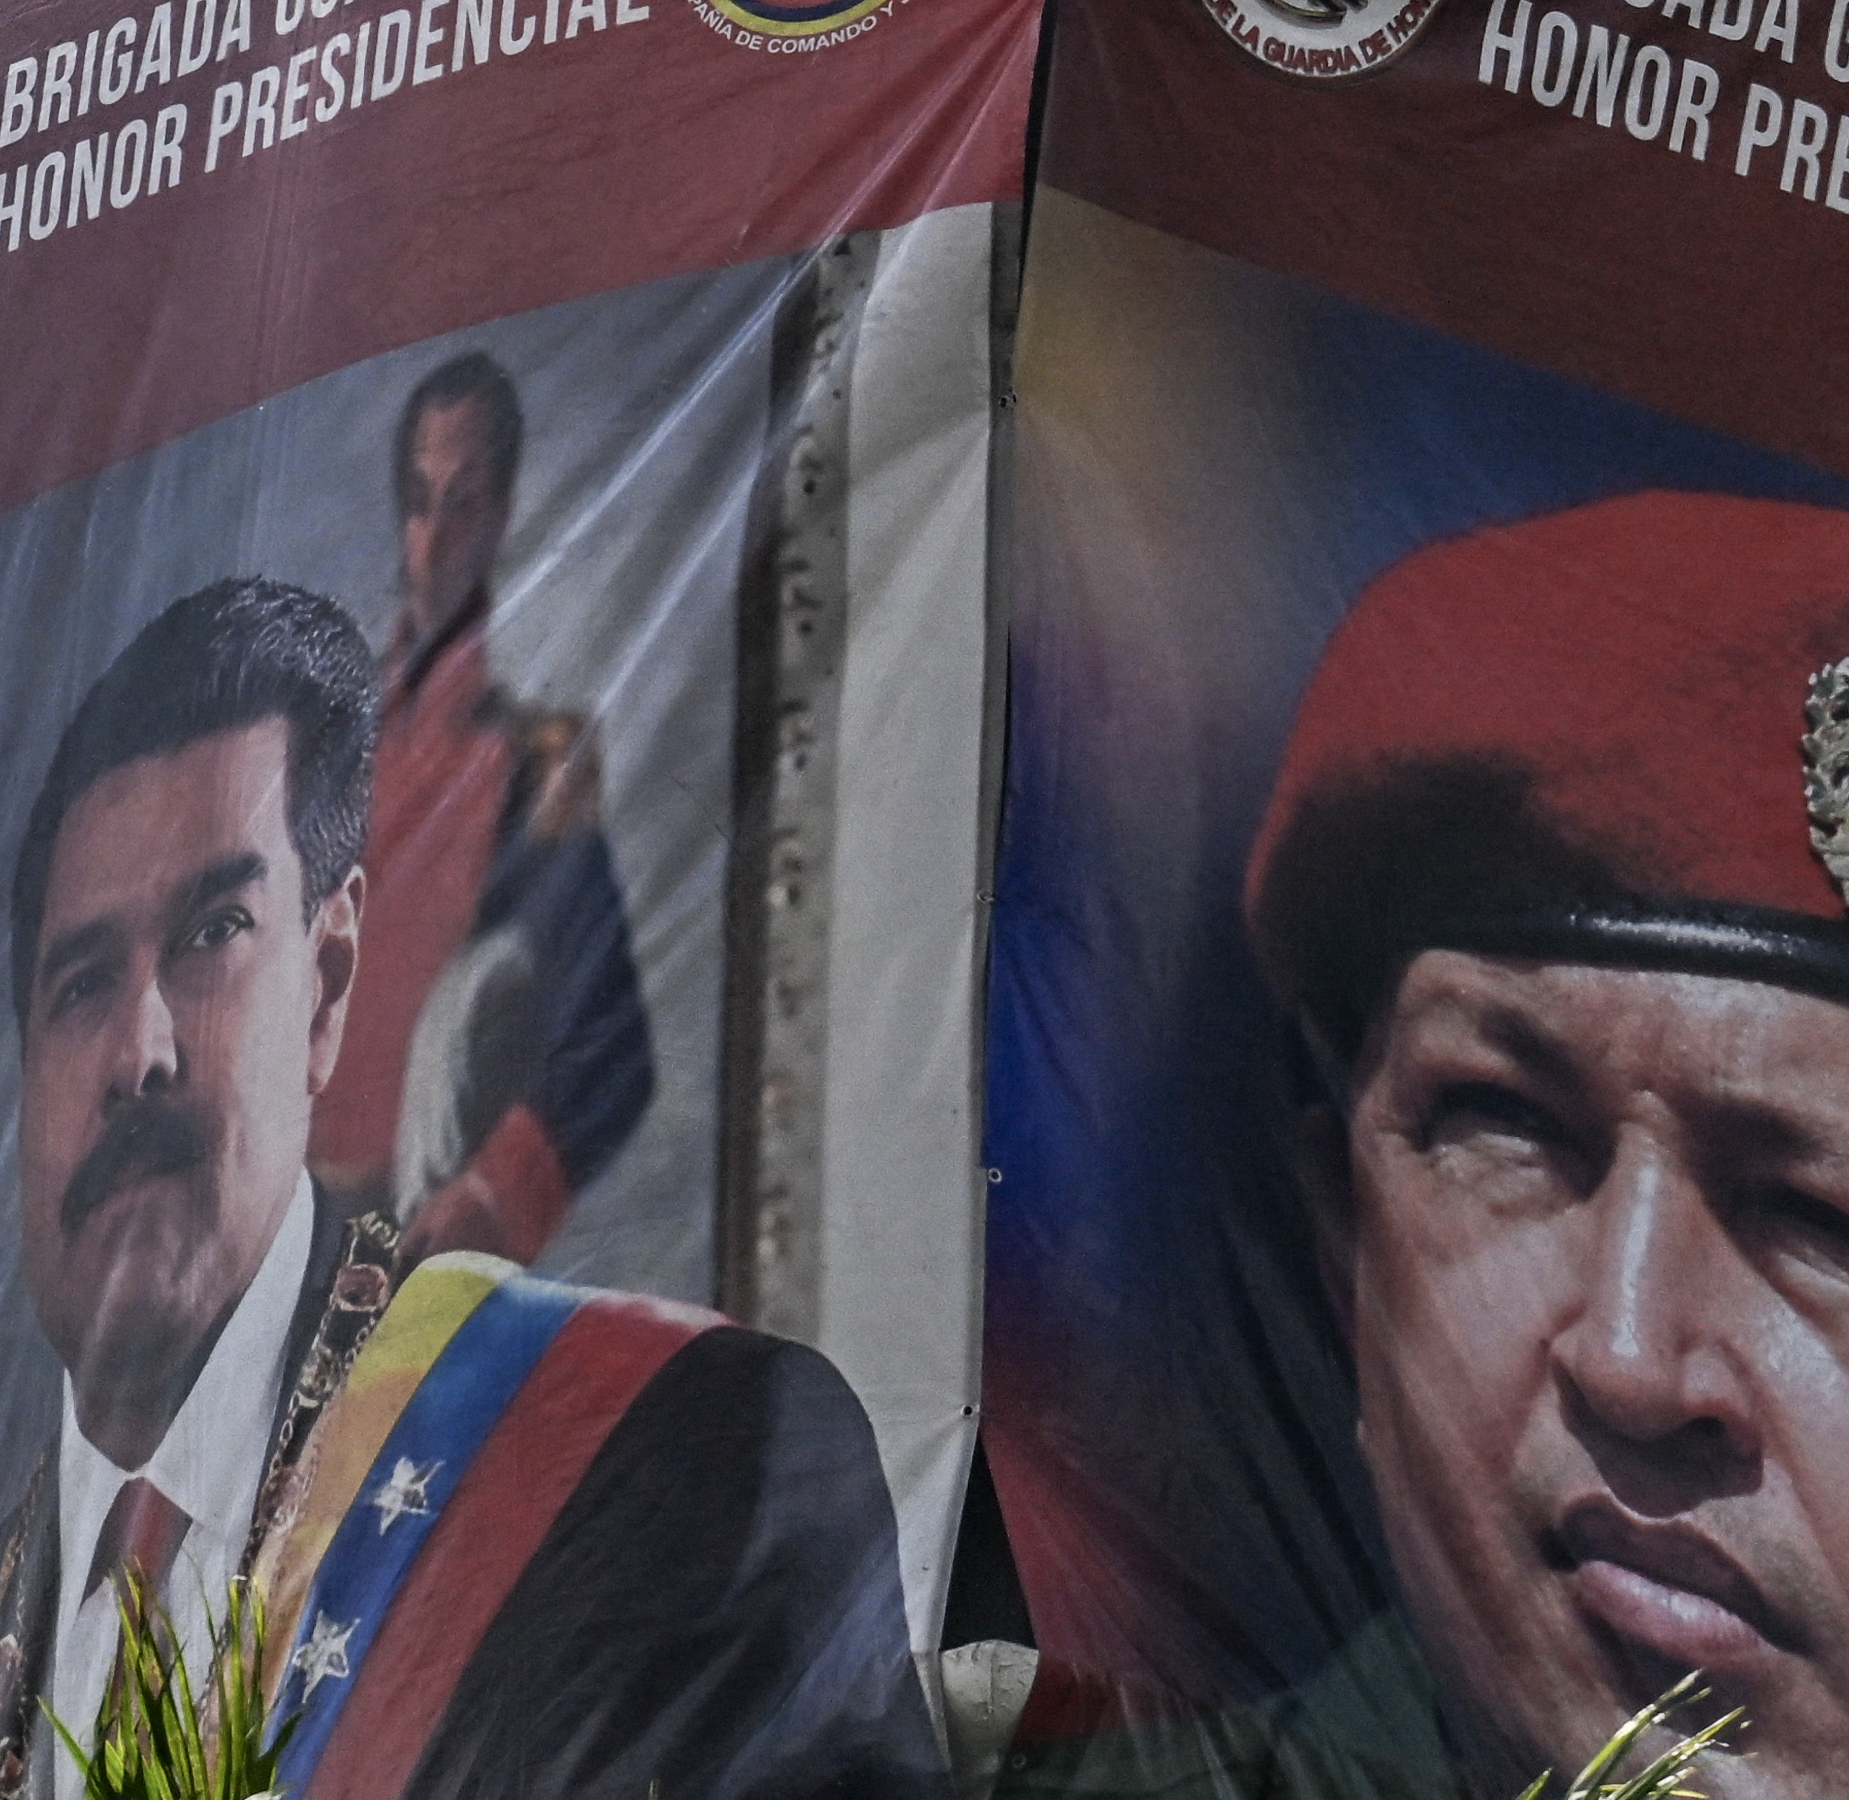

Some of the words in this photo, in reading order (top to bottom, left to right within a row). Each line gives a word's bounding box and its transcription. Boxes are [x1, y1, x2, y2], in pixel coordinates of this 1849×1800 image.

[735, 30, 762, 51] DE
[767, 15, 878, 54] COMANDO
[880, 0, 895, 18] Y
[1232, 14, 1260, 49] LA
[1263, 36, 1361, 73] GUARDIA
[1358, 29, 1392, 66] DE
